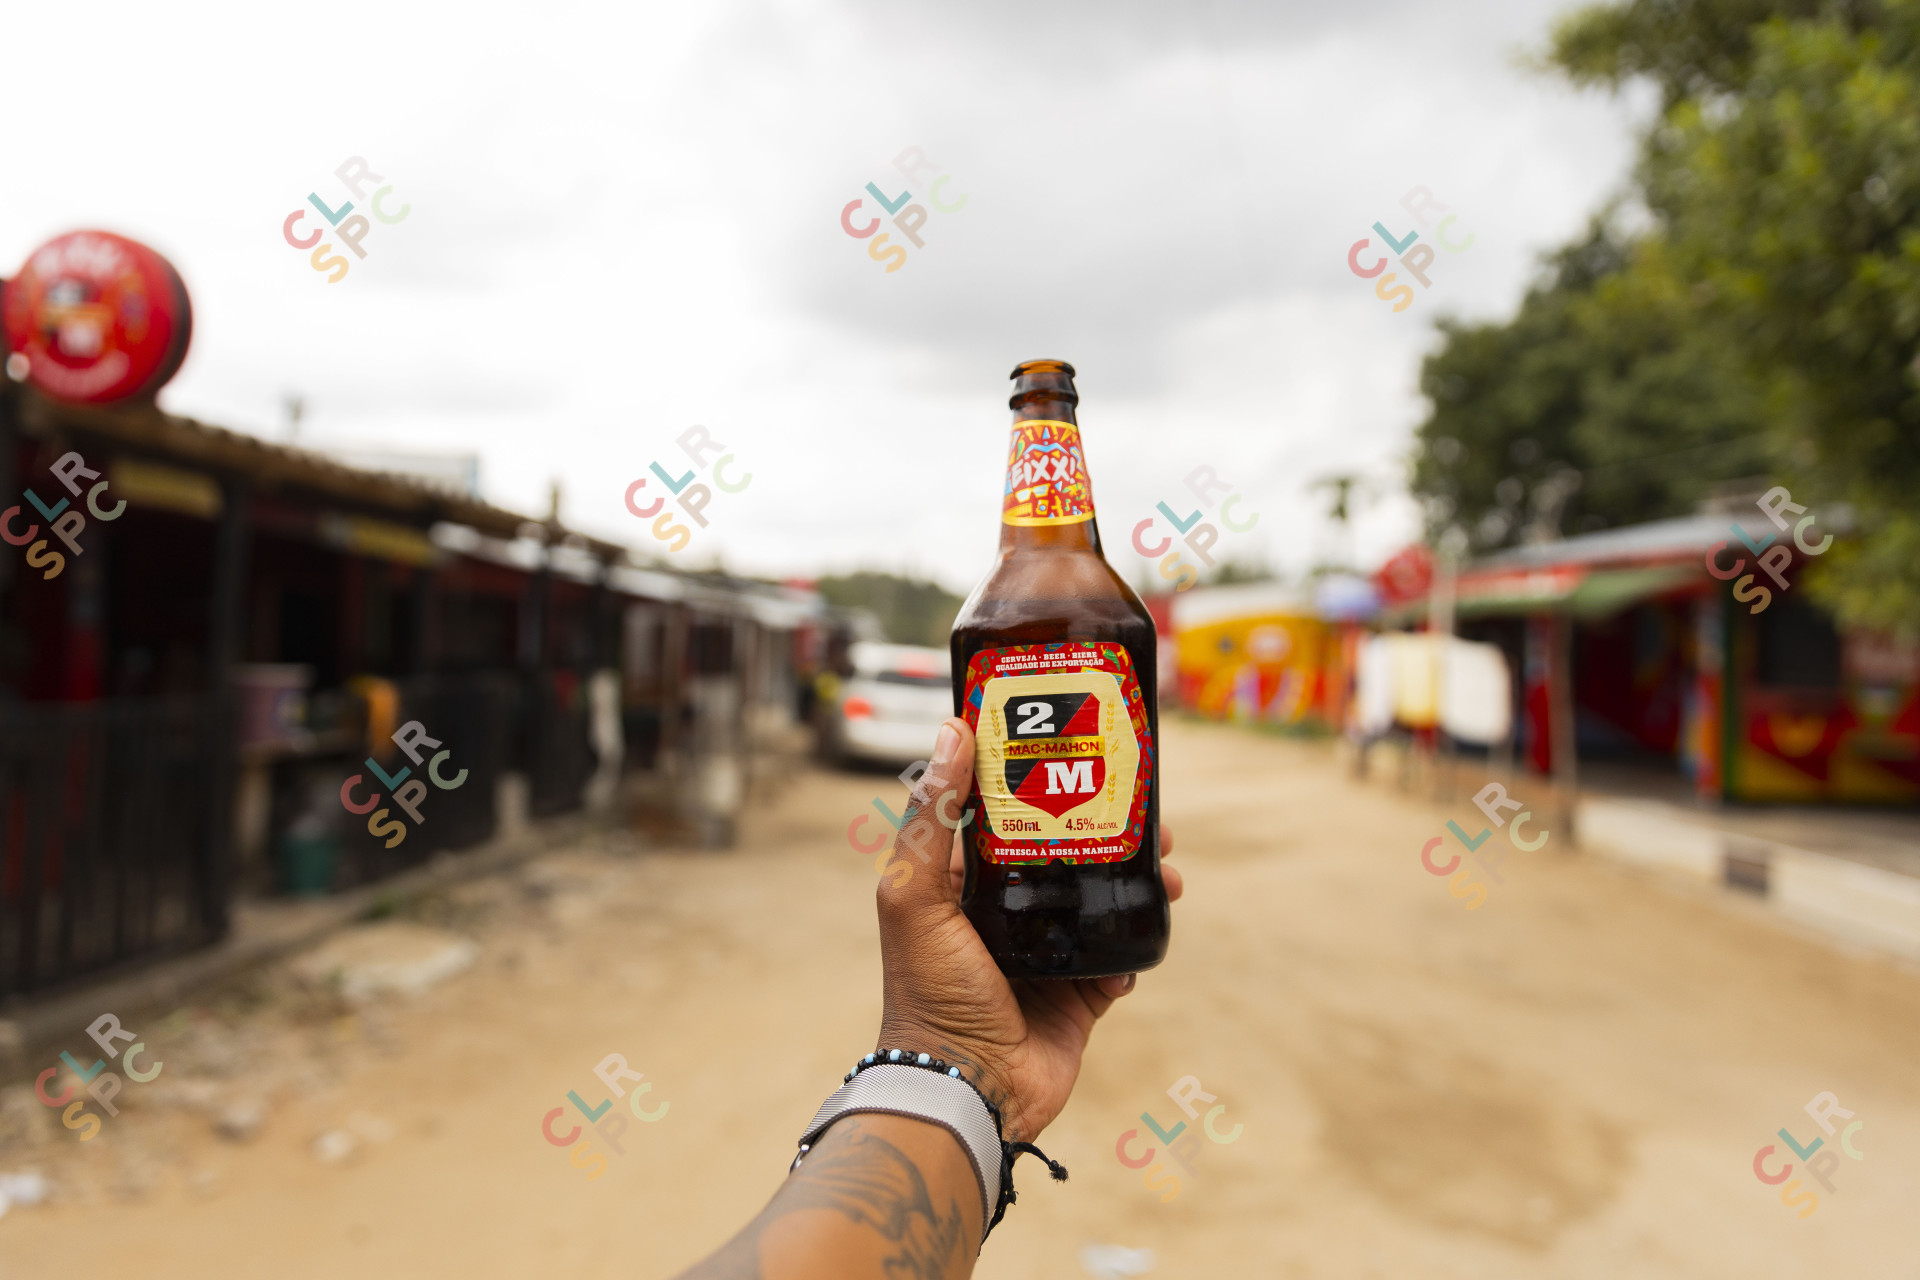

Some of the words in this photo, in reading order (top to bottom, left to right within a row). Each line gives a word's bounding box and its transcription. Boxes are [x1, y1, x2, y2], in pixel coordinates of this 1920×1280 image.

[995, 661, 1038, 672] QUALIDADE
[1039, 660, 1051, 668] DE
[1052, 657, 1104, 667] EXPORTAÇÃO
[1001, 655, 1037, 663] CERVEJA
[1016, 701, 1056, 735] 2
[1044, 760, 1096, 795] M
[1065, 817, 1095, 831] 4.5%
[994, 848, 1038, 856] REFRESCA
[1040, 847, 1047, 856] À
[1049, 848, 1080, 856] NOSSA
[1082, 845, 1124, 855] MANEIRA
